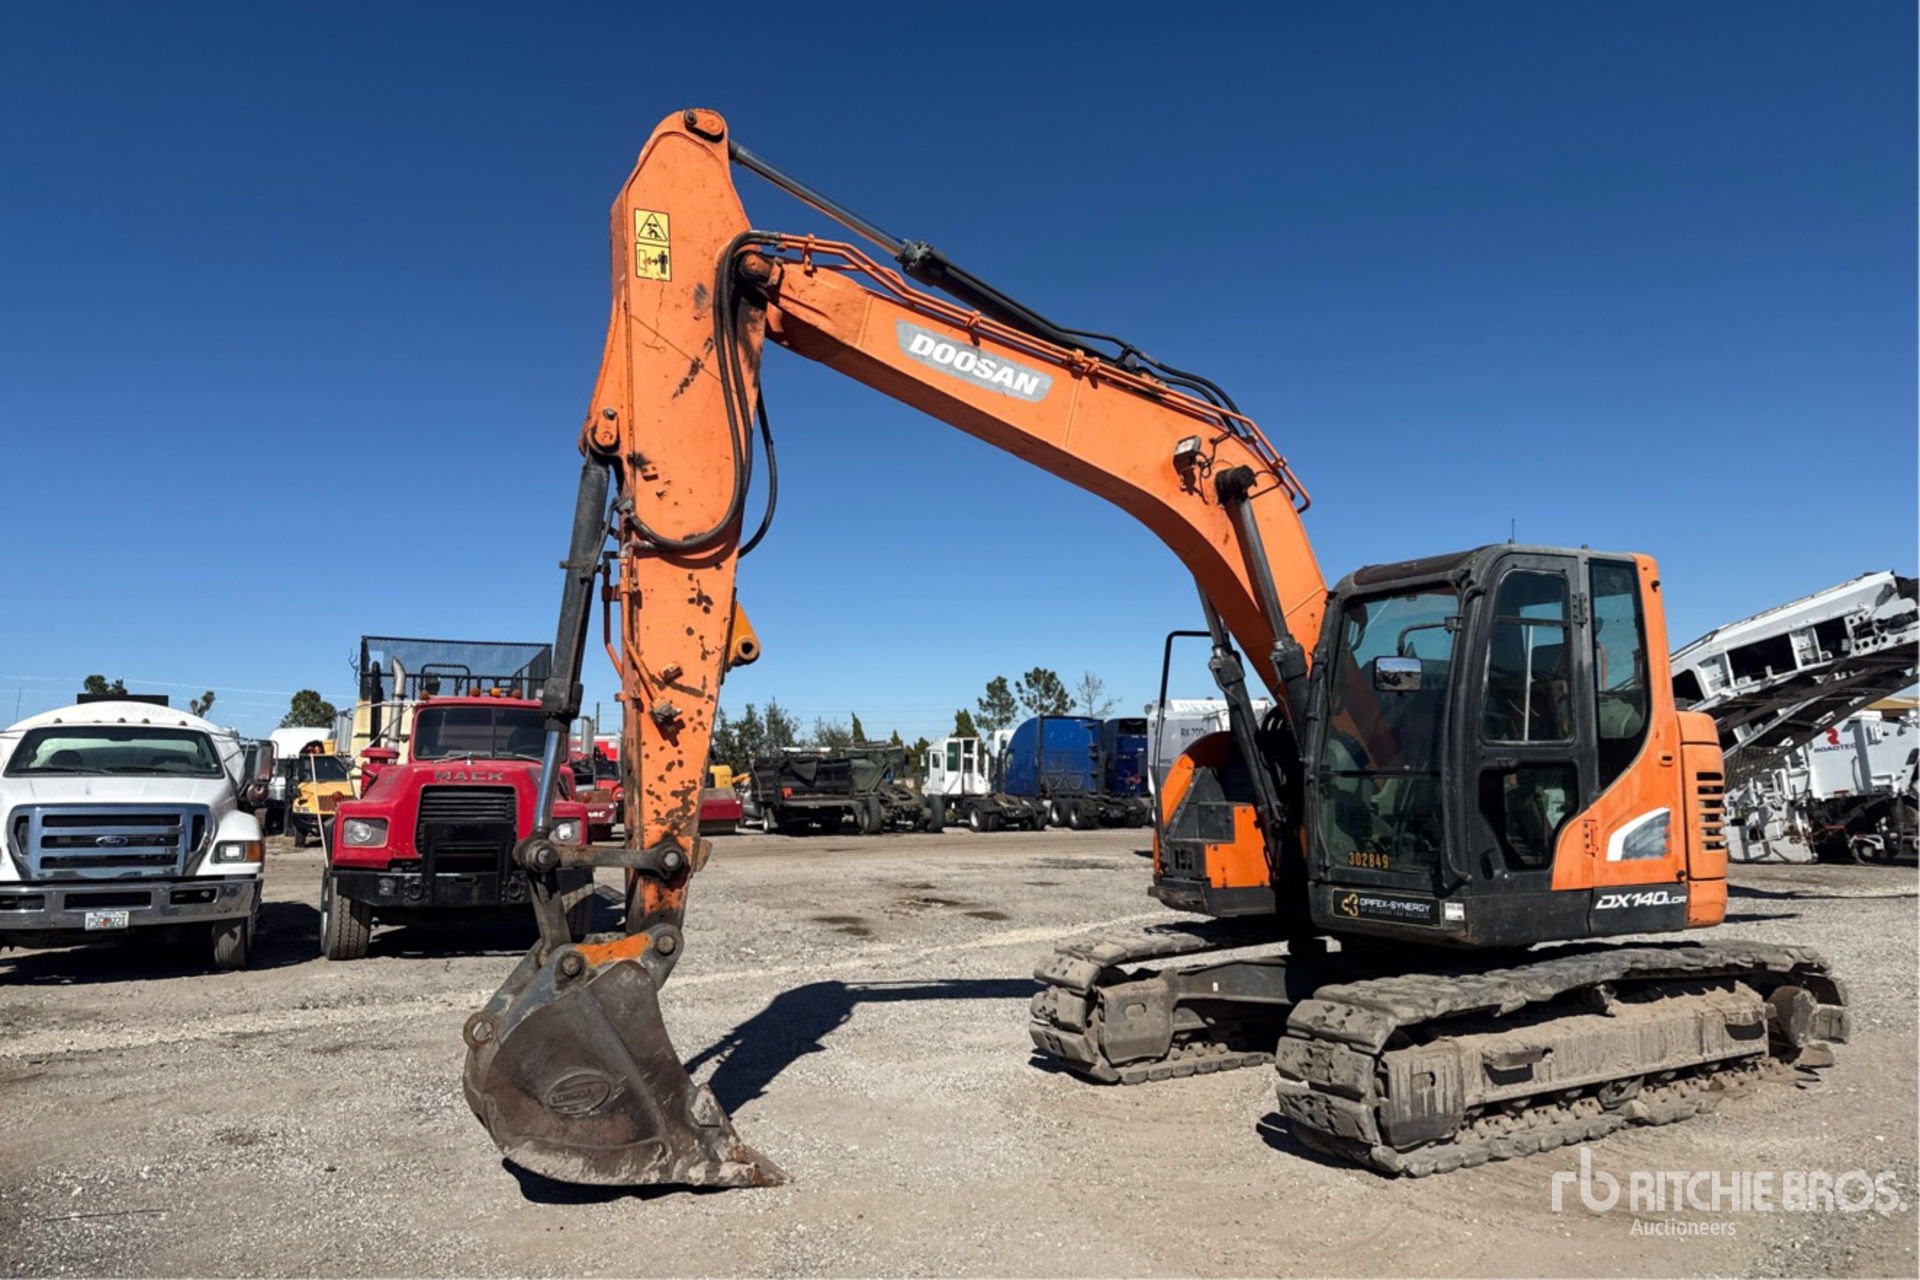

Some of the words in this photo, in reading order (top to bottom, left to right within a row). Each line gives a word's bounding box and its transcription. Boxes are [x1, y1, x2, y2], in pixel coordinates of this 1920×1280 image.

[909, 333, 1040, 395] DOOSAN
[434, 770, 504, 781] MACK
[1348, 851, 1389, 869] 302849
